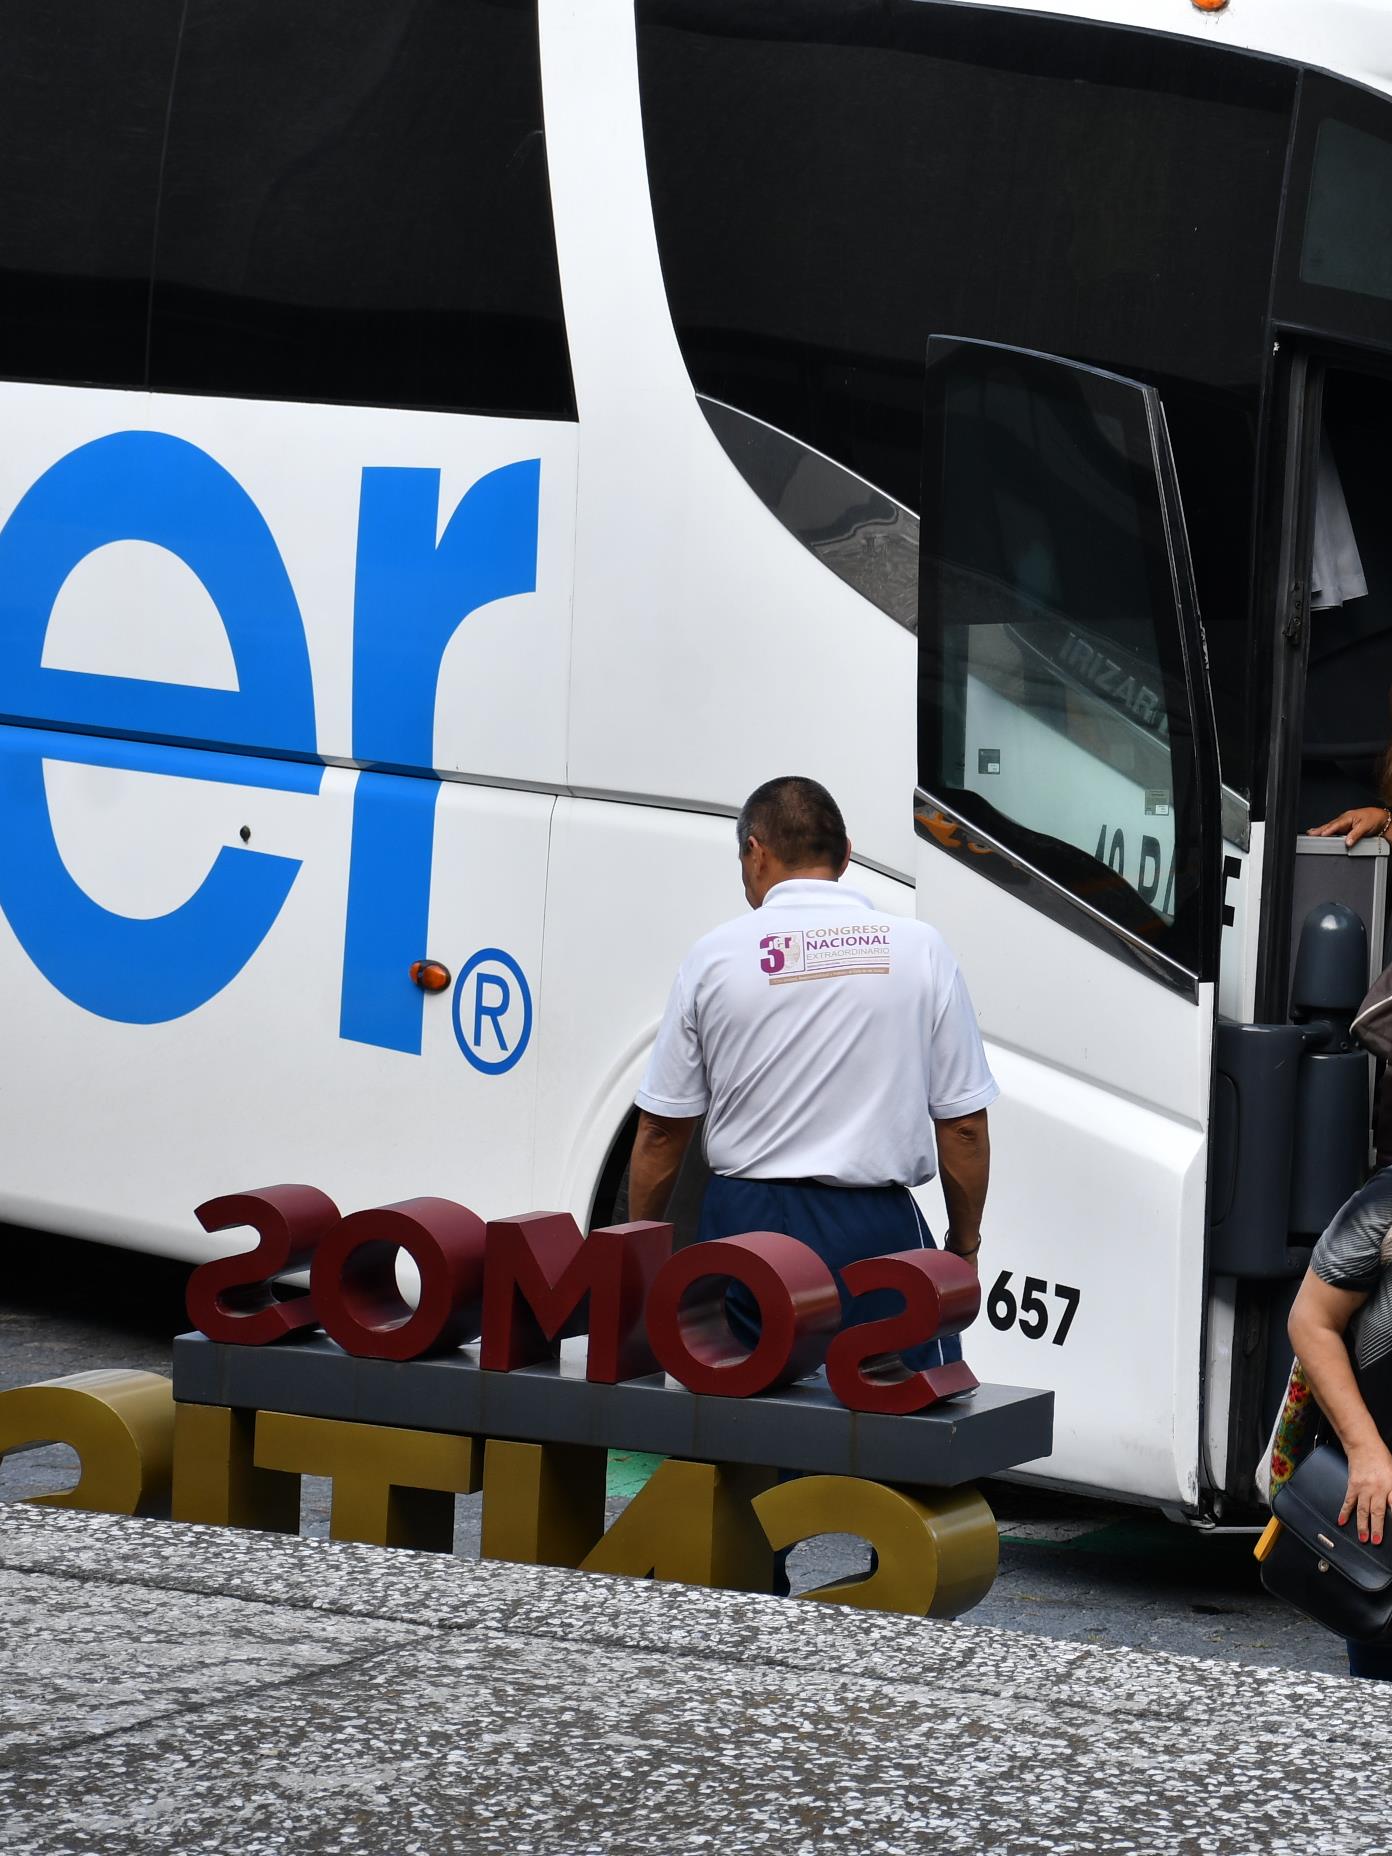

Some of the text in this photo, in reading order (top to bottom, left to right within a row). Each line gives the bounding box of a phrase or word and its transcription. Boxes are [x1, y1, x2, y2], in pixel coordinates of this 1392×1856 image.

[806, 924, 890, 939] CONGRESO
[806, 935, 890, 951] NACIONAL
[806, 947, 890, 961] EXTRAORDINARIO
[986, 1269, 1081, 1347] 657
